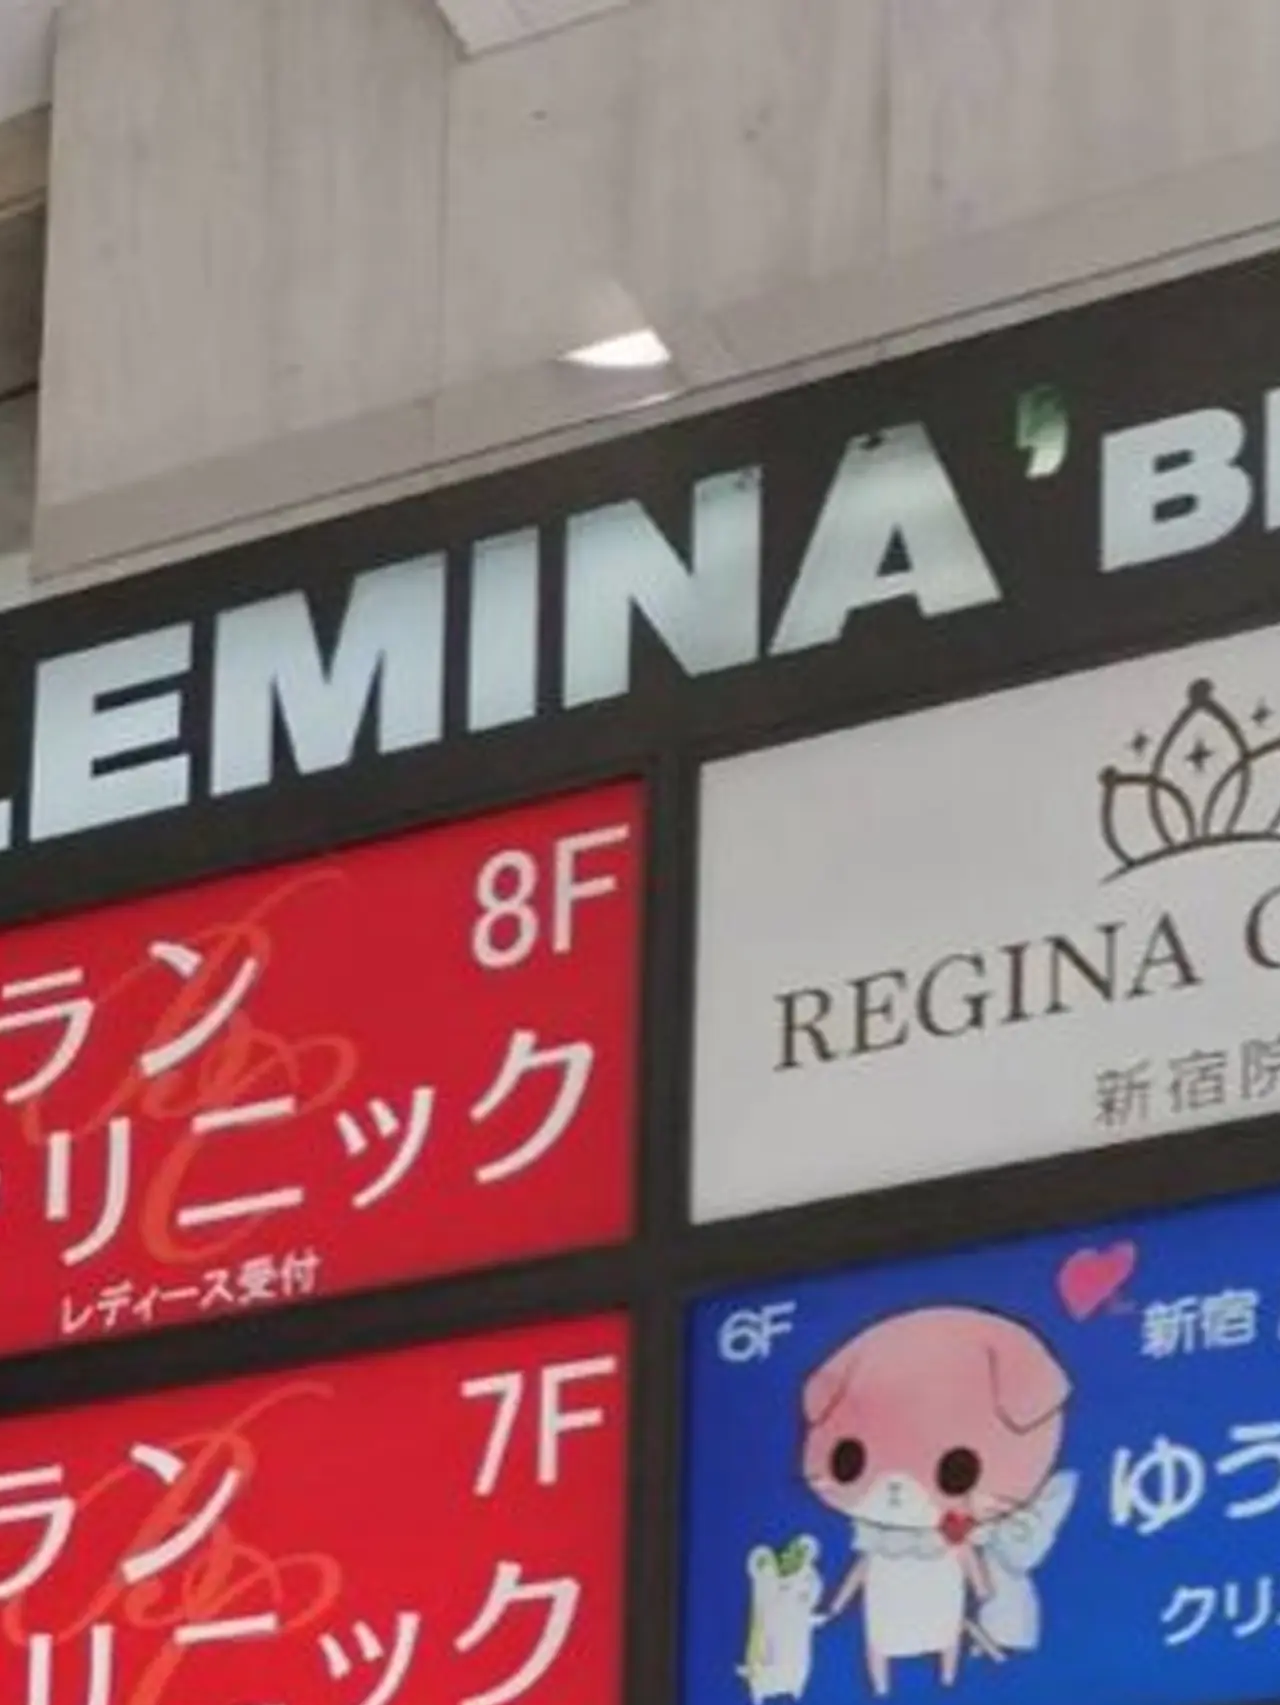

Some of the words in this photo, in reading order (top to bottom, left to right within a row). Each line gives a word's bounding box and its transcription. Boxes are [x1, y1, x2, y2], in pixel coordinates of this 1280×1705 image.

[472, 825, 629, 969] 8F
[772, 912, 1202, 1072] REGINA
[62, 1249, 320, 1335] レディース受付
[719, 1300, 795, 1362] 6F
[1141, 1288, 1258, 1359] 新宿
[461, 1357, 615, 1496] 7F
